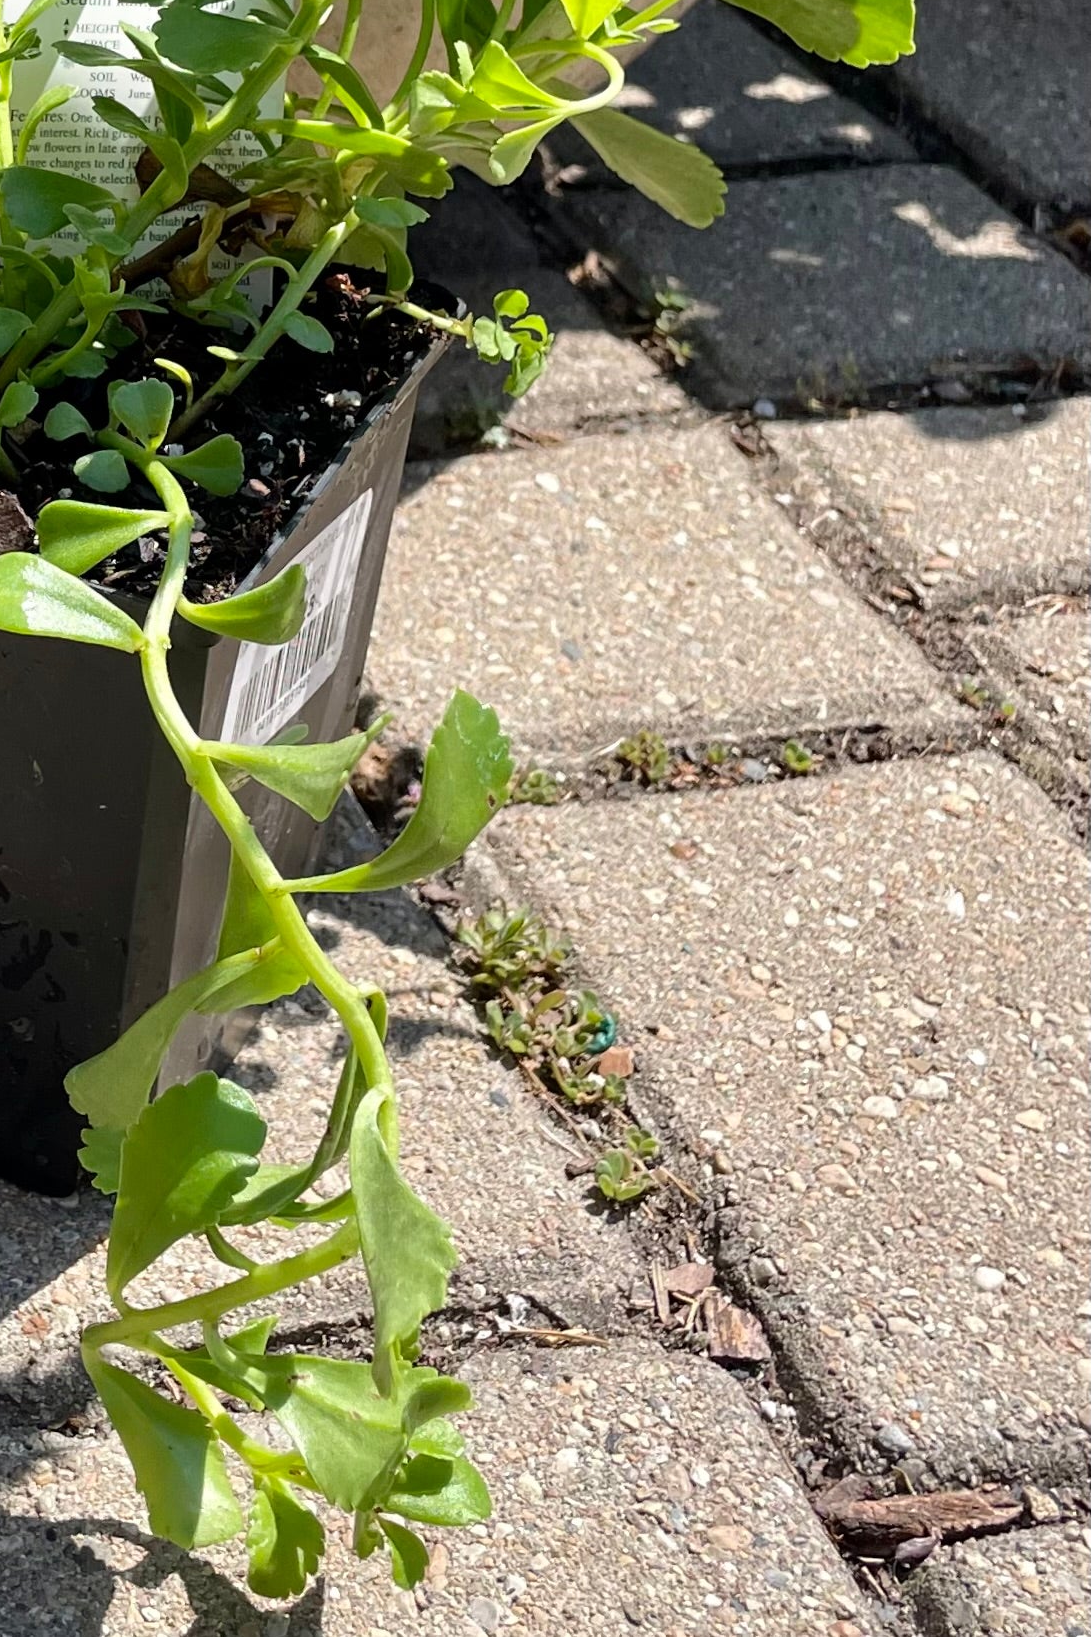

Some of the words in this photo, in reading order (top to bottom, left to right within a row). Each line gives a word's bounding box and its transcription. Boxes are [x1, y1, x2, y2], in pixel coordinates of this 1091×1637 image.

[89, 72, 117, 83] SOIL
[130, 71, 152, 83] We
[74, 88, 116, 99] OOMS
[127, 89, 151, 100] June
[10, 109, 67, 123] Feres:
[71, 112, 93, 124] One
[84, 127, 109, 139] Rich
[44, 141, 82, 154] flowers
[85, 143, 95, 153] in
[98, 142, 118, 154] late
[120, 143, 148, 157] sprin
[238, 145, 263, 157] then
[49, 157, 92, 172] changes
[94, 159, 105, 169] to
[108, 158, 125, 169] red
[214, 161, 245, 174] popul
[99, 172, 137, 185] selecti
[211, 258, 231, 270] soil
